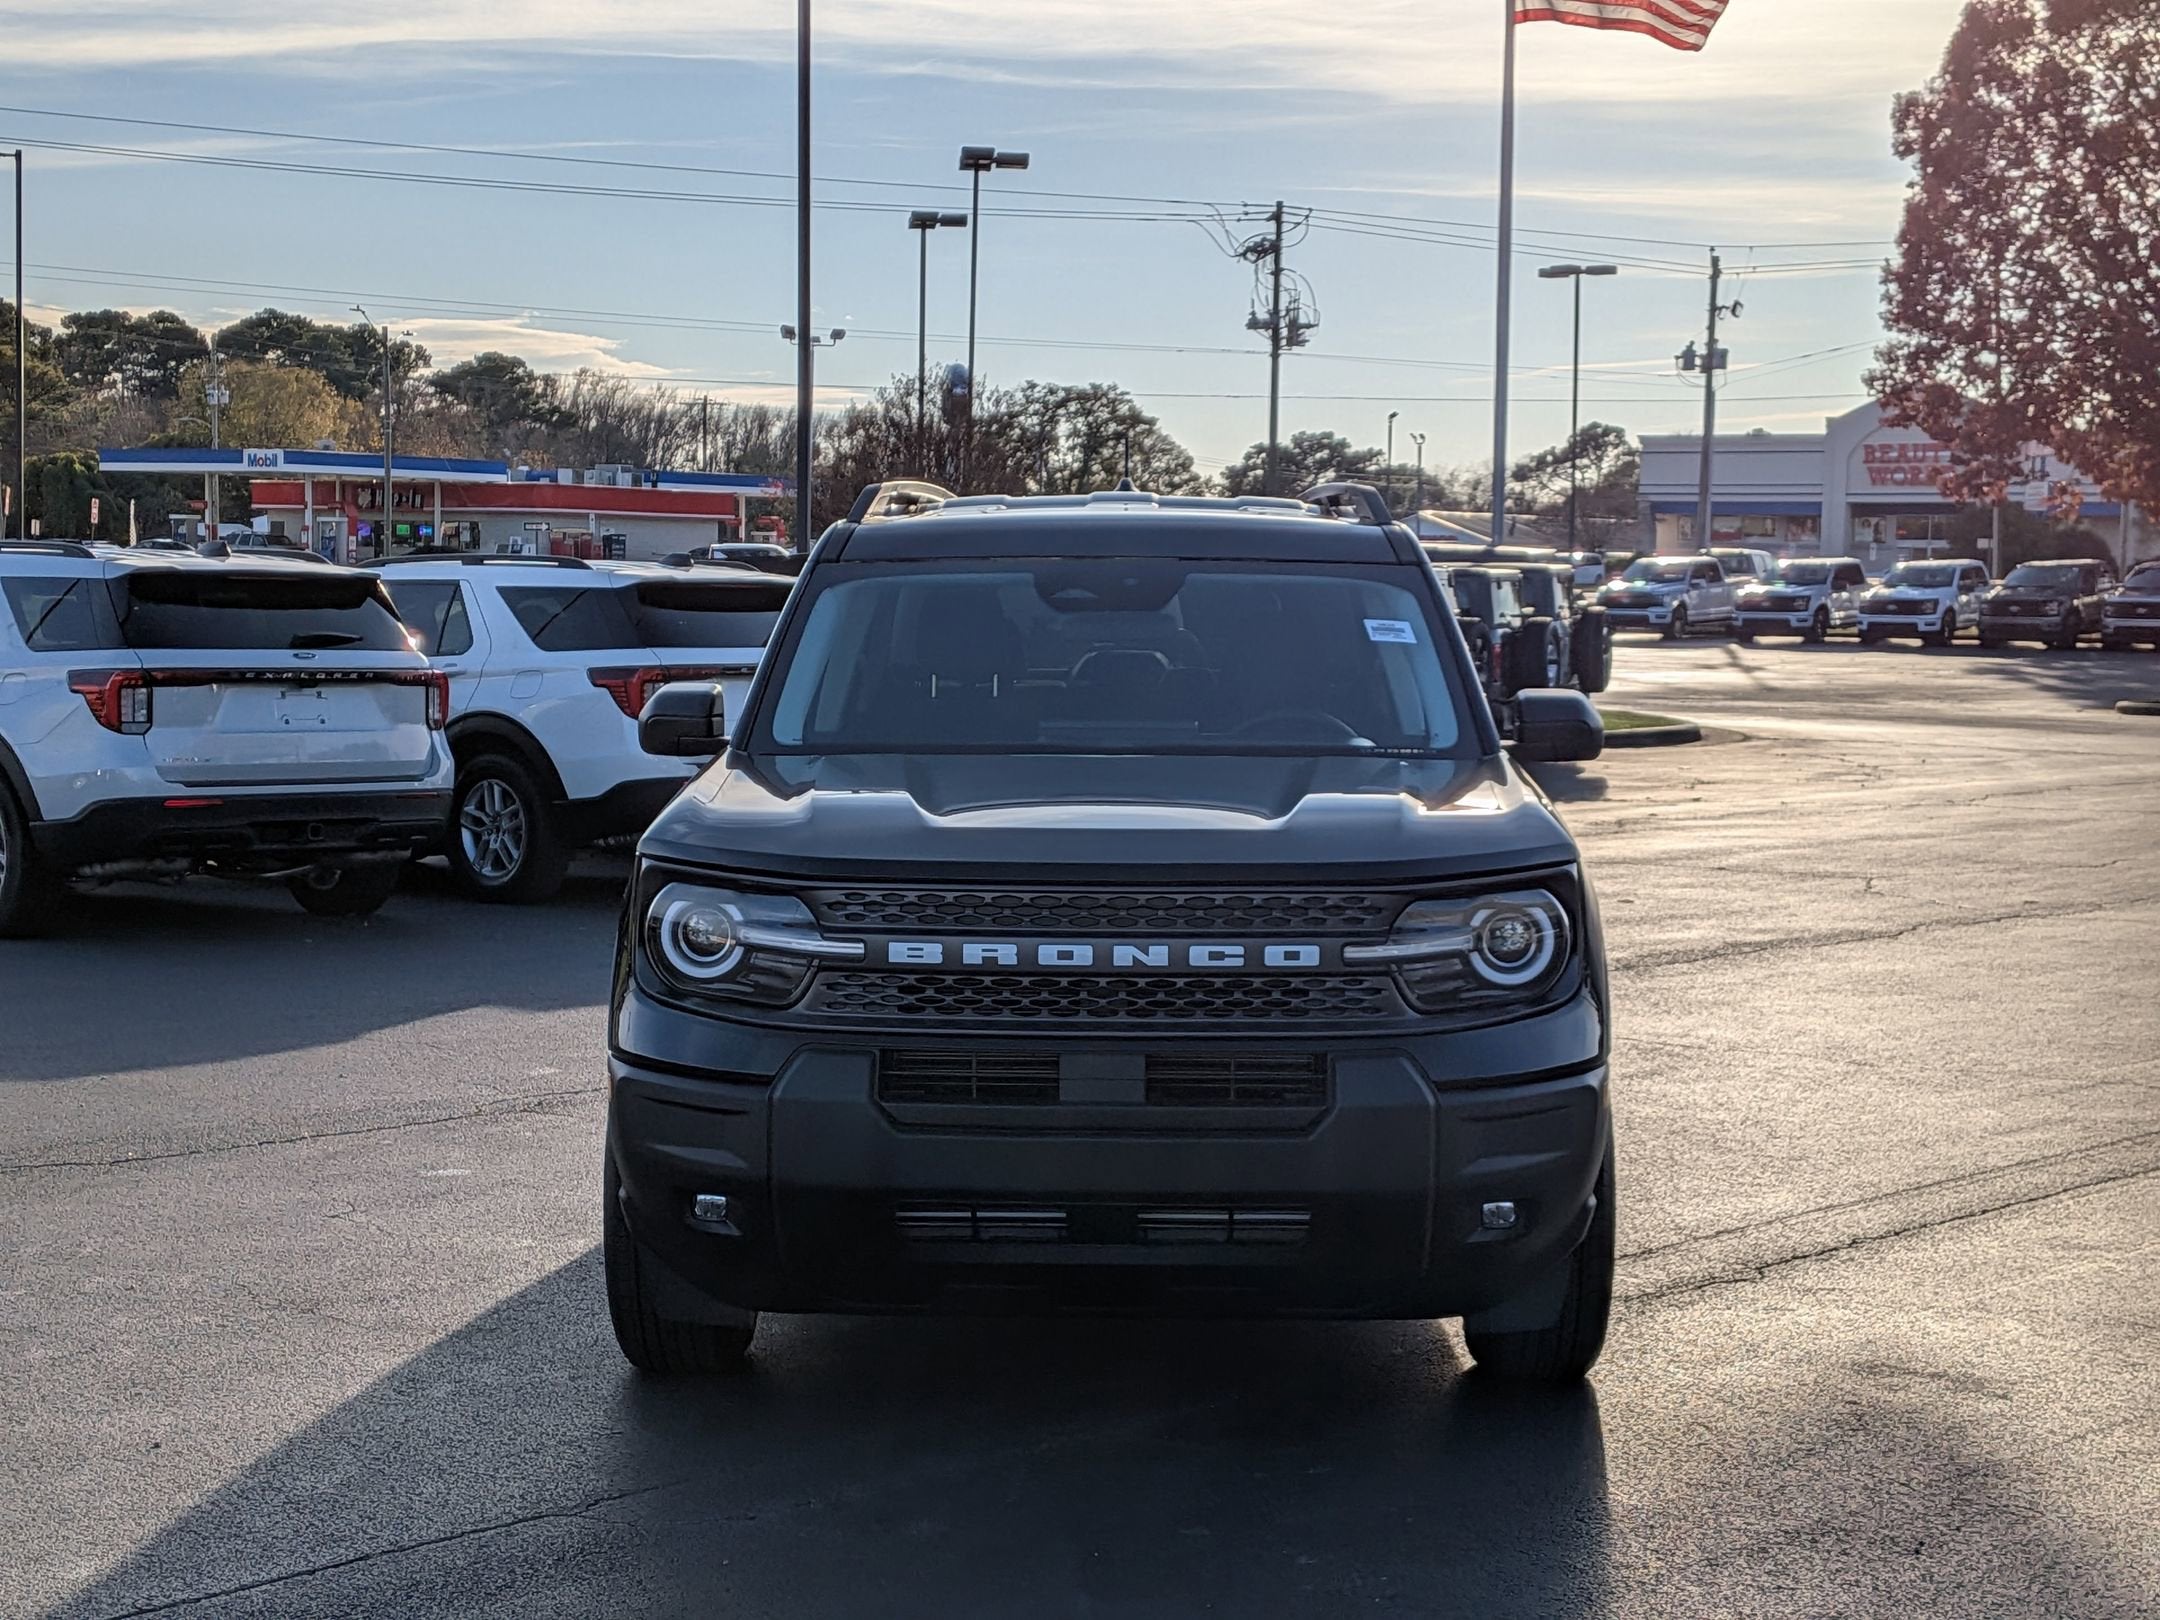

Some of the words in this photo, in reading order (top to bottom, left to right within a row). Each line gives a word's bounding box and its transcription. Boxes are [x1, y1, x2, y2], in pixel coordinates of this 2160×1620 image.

[247, 453, 278, 468] Mobil
[1863, 443, 1951, 464] BEAUT
[887, 941, 1321, 967] BRONCO
